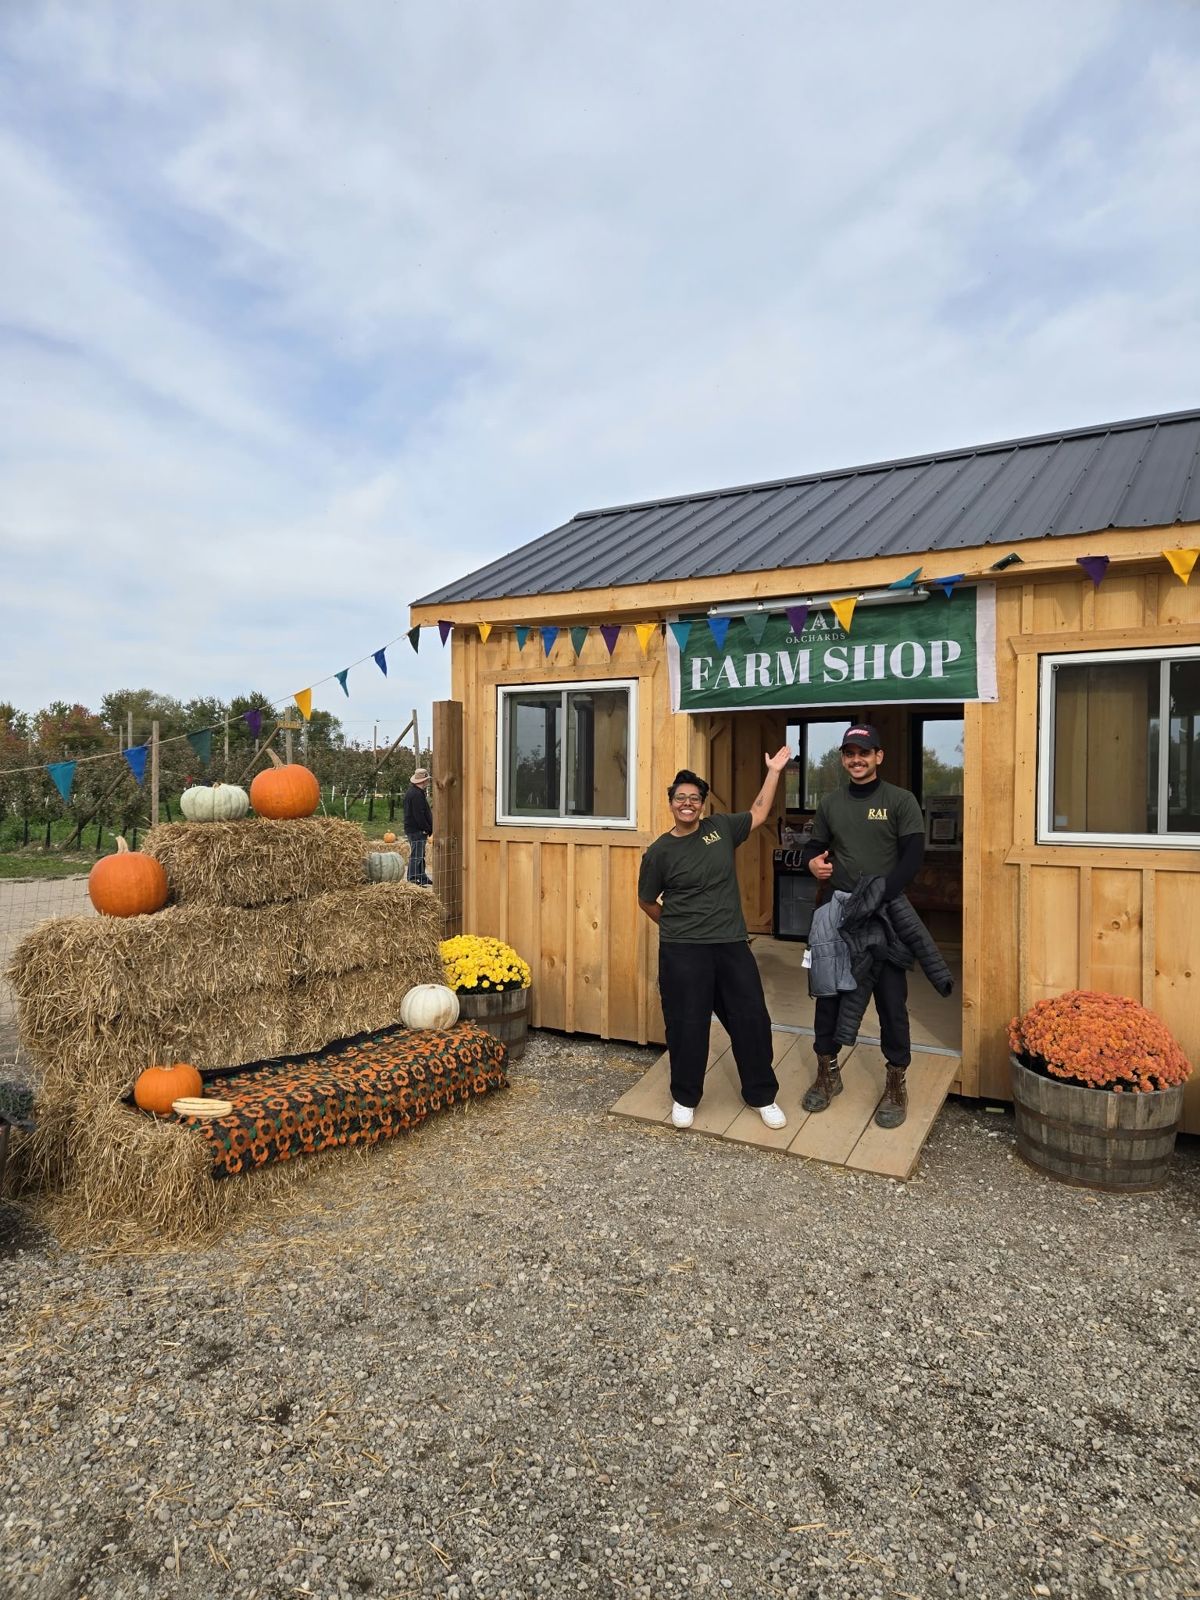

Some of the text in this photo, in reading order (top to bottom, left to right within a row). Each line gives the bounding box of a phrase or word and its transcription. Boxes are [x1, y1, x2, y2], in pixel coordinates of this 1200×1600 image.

[690, 640, 962, 691] FARM SHOP
[868, 808, 888, 817] RAI
[702, 830, 721, 844] RAI
